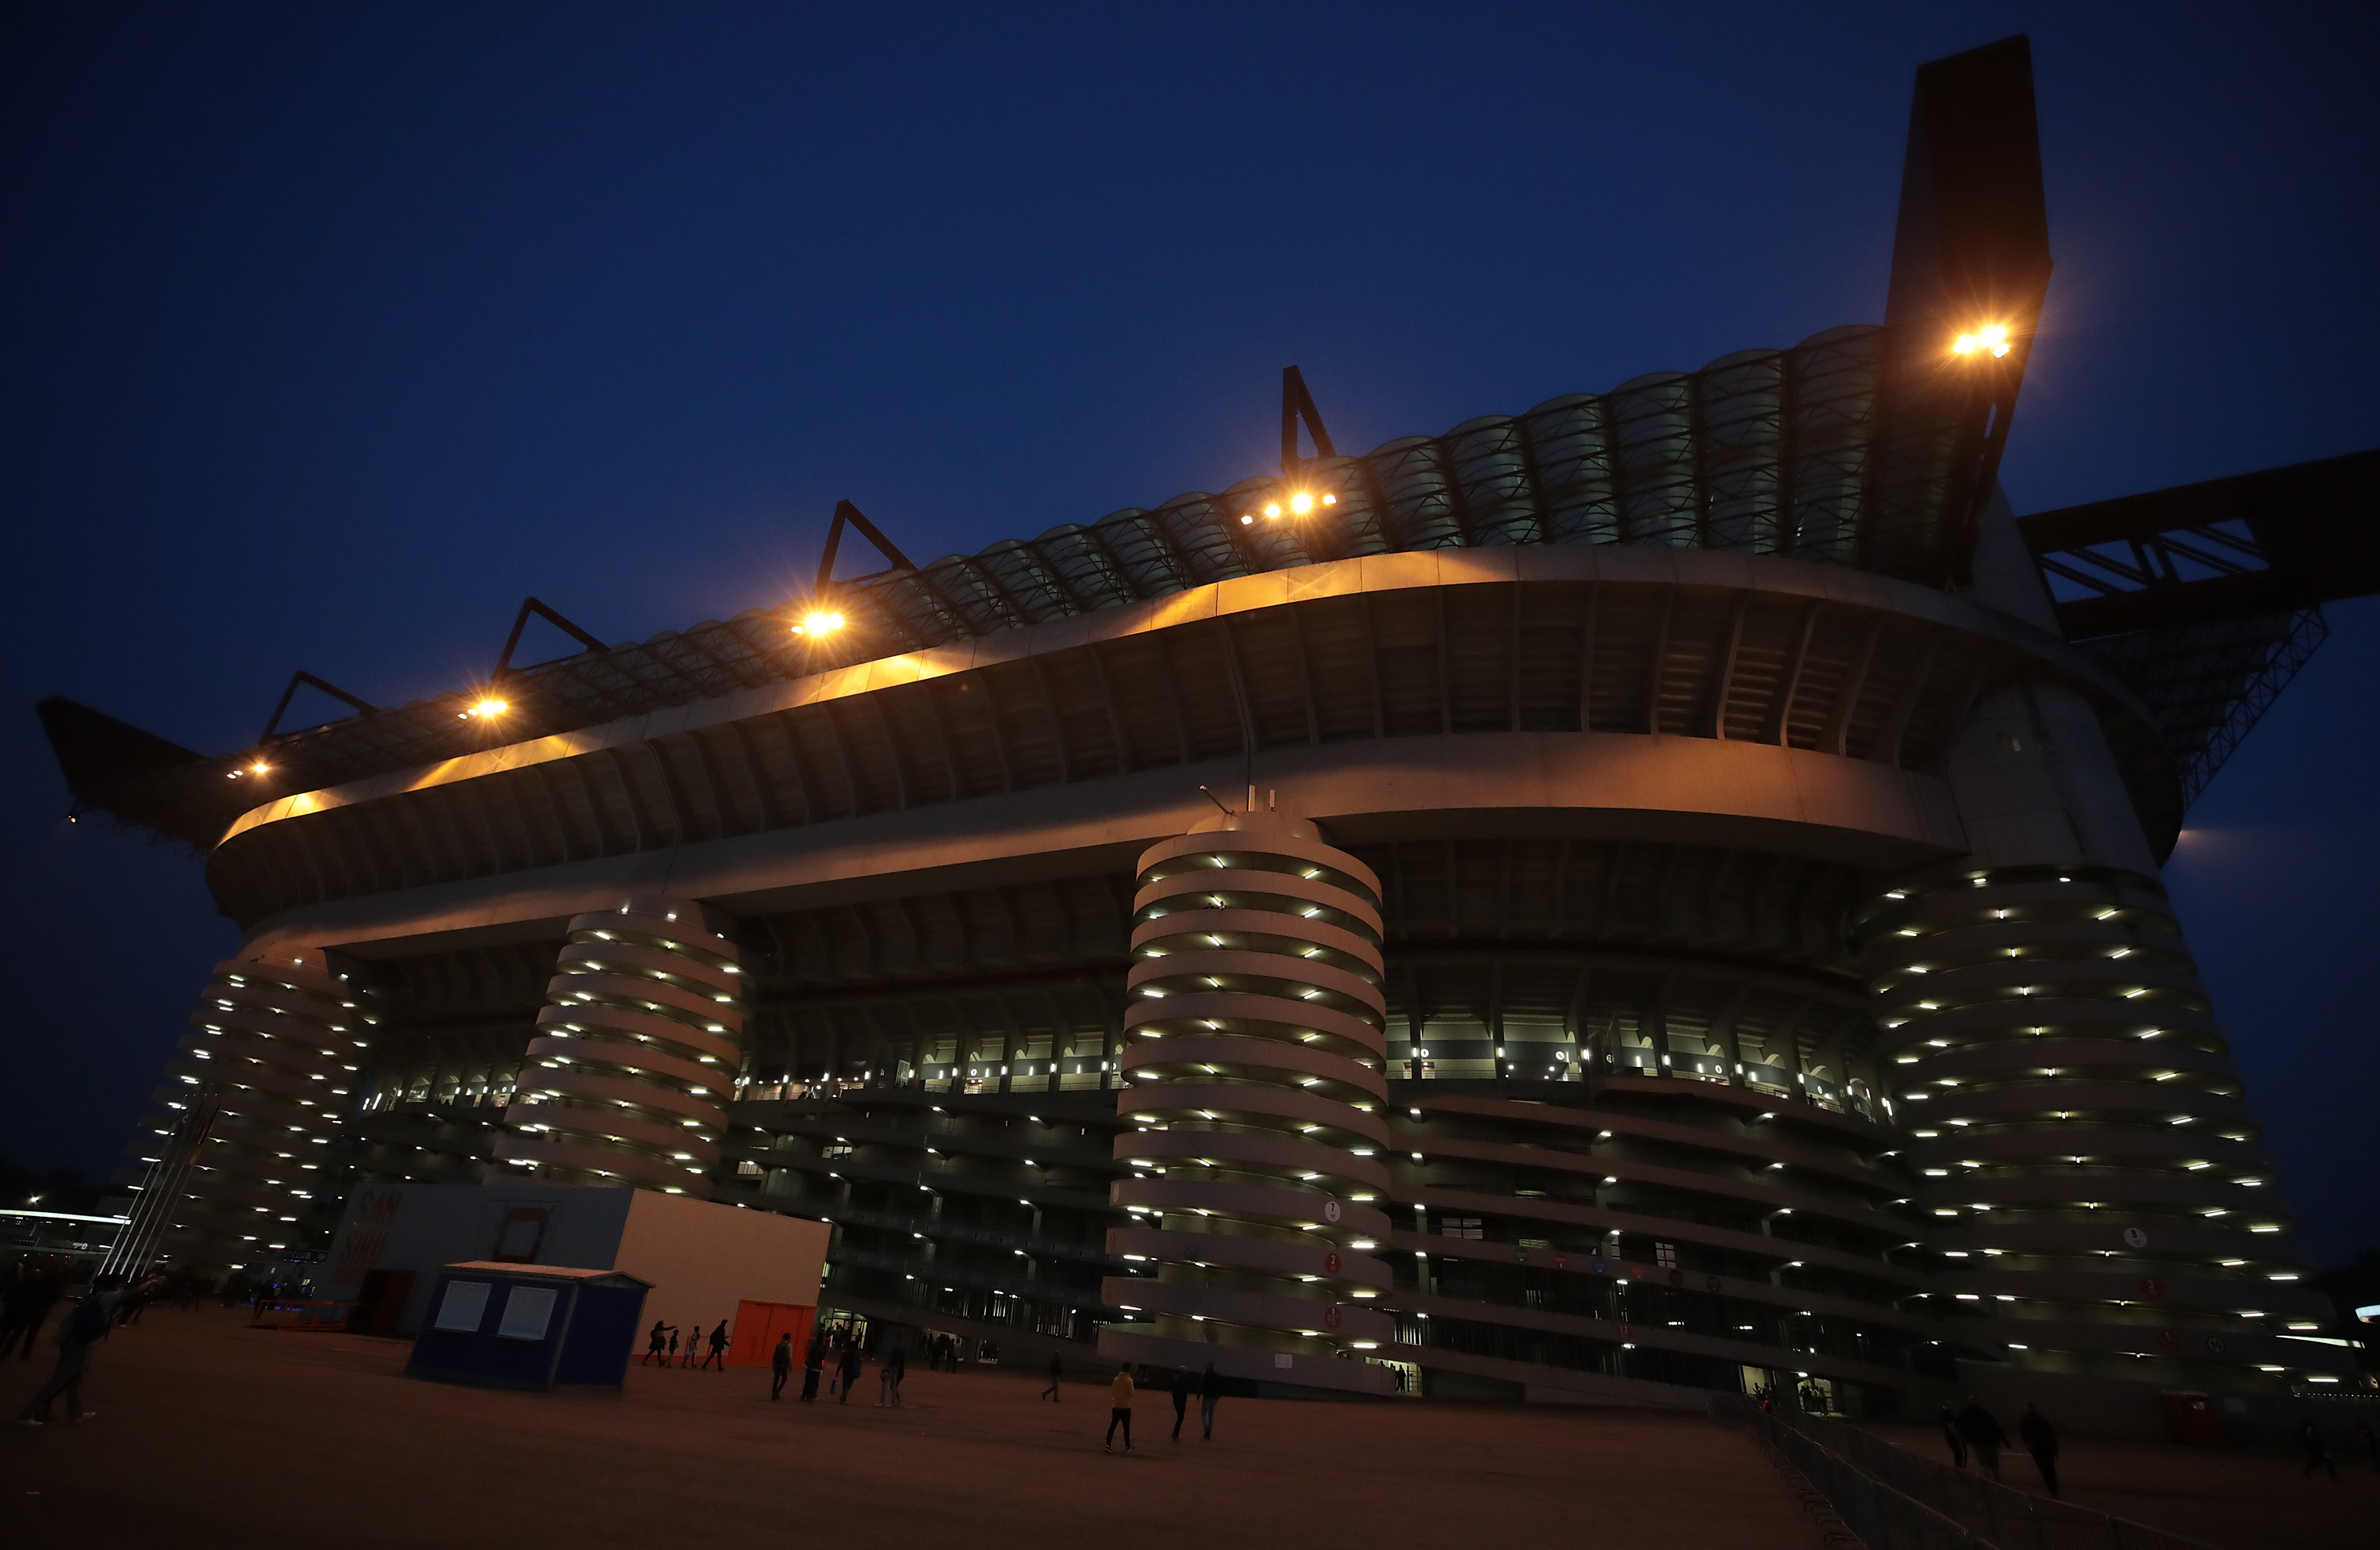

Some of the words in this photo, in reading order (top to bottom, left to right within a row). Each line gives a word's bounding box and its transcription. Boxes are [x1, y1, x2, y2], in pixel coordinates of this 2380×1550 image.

[2131, 1230, 2137, 1238] 8
[291, 1251, 312, 1260] CLUB
[2210, 1341, 2222, 1350] 10
